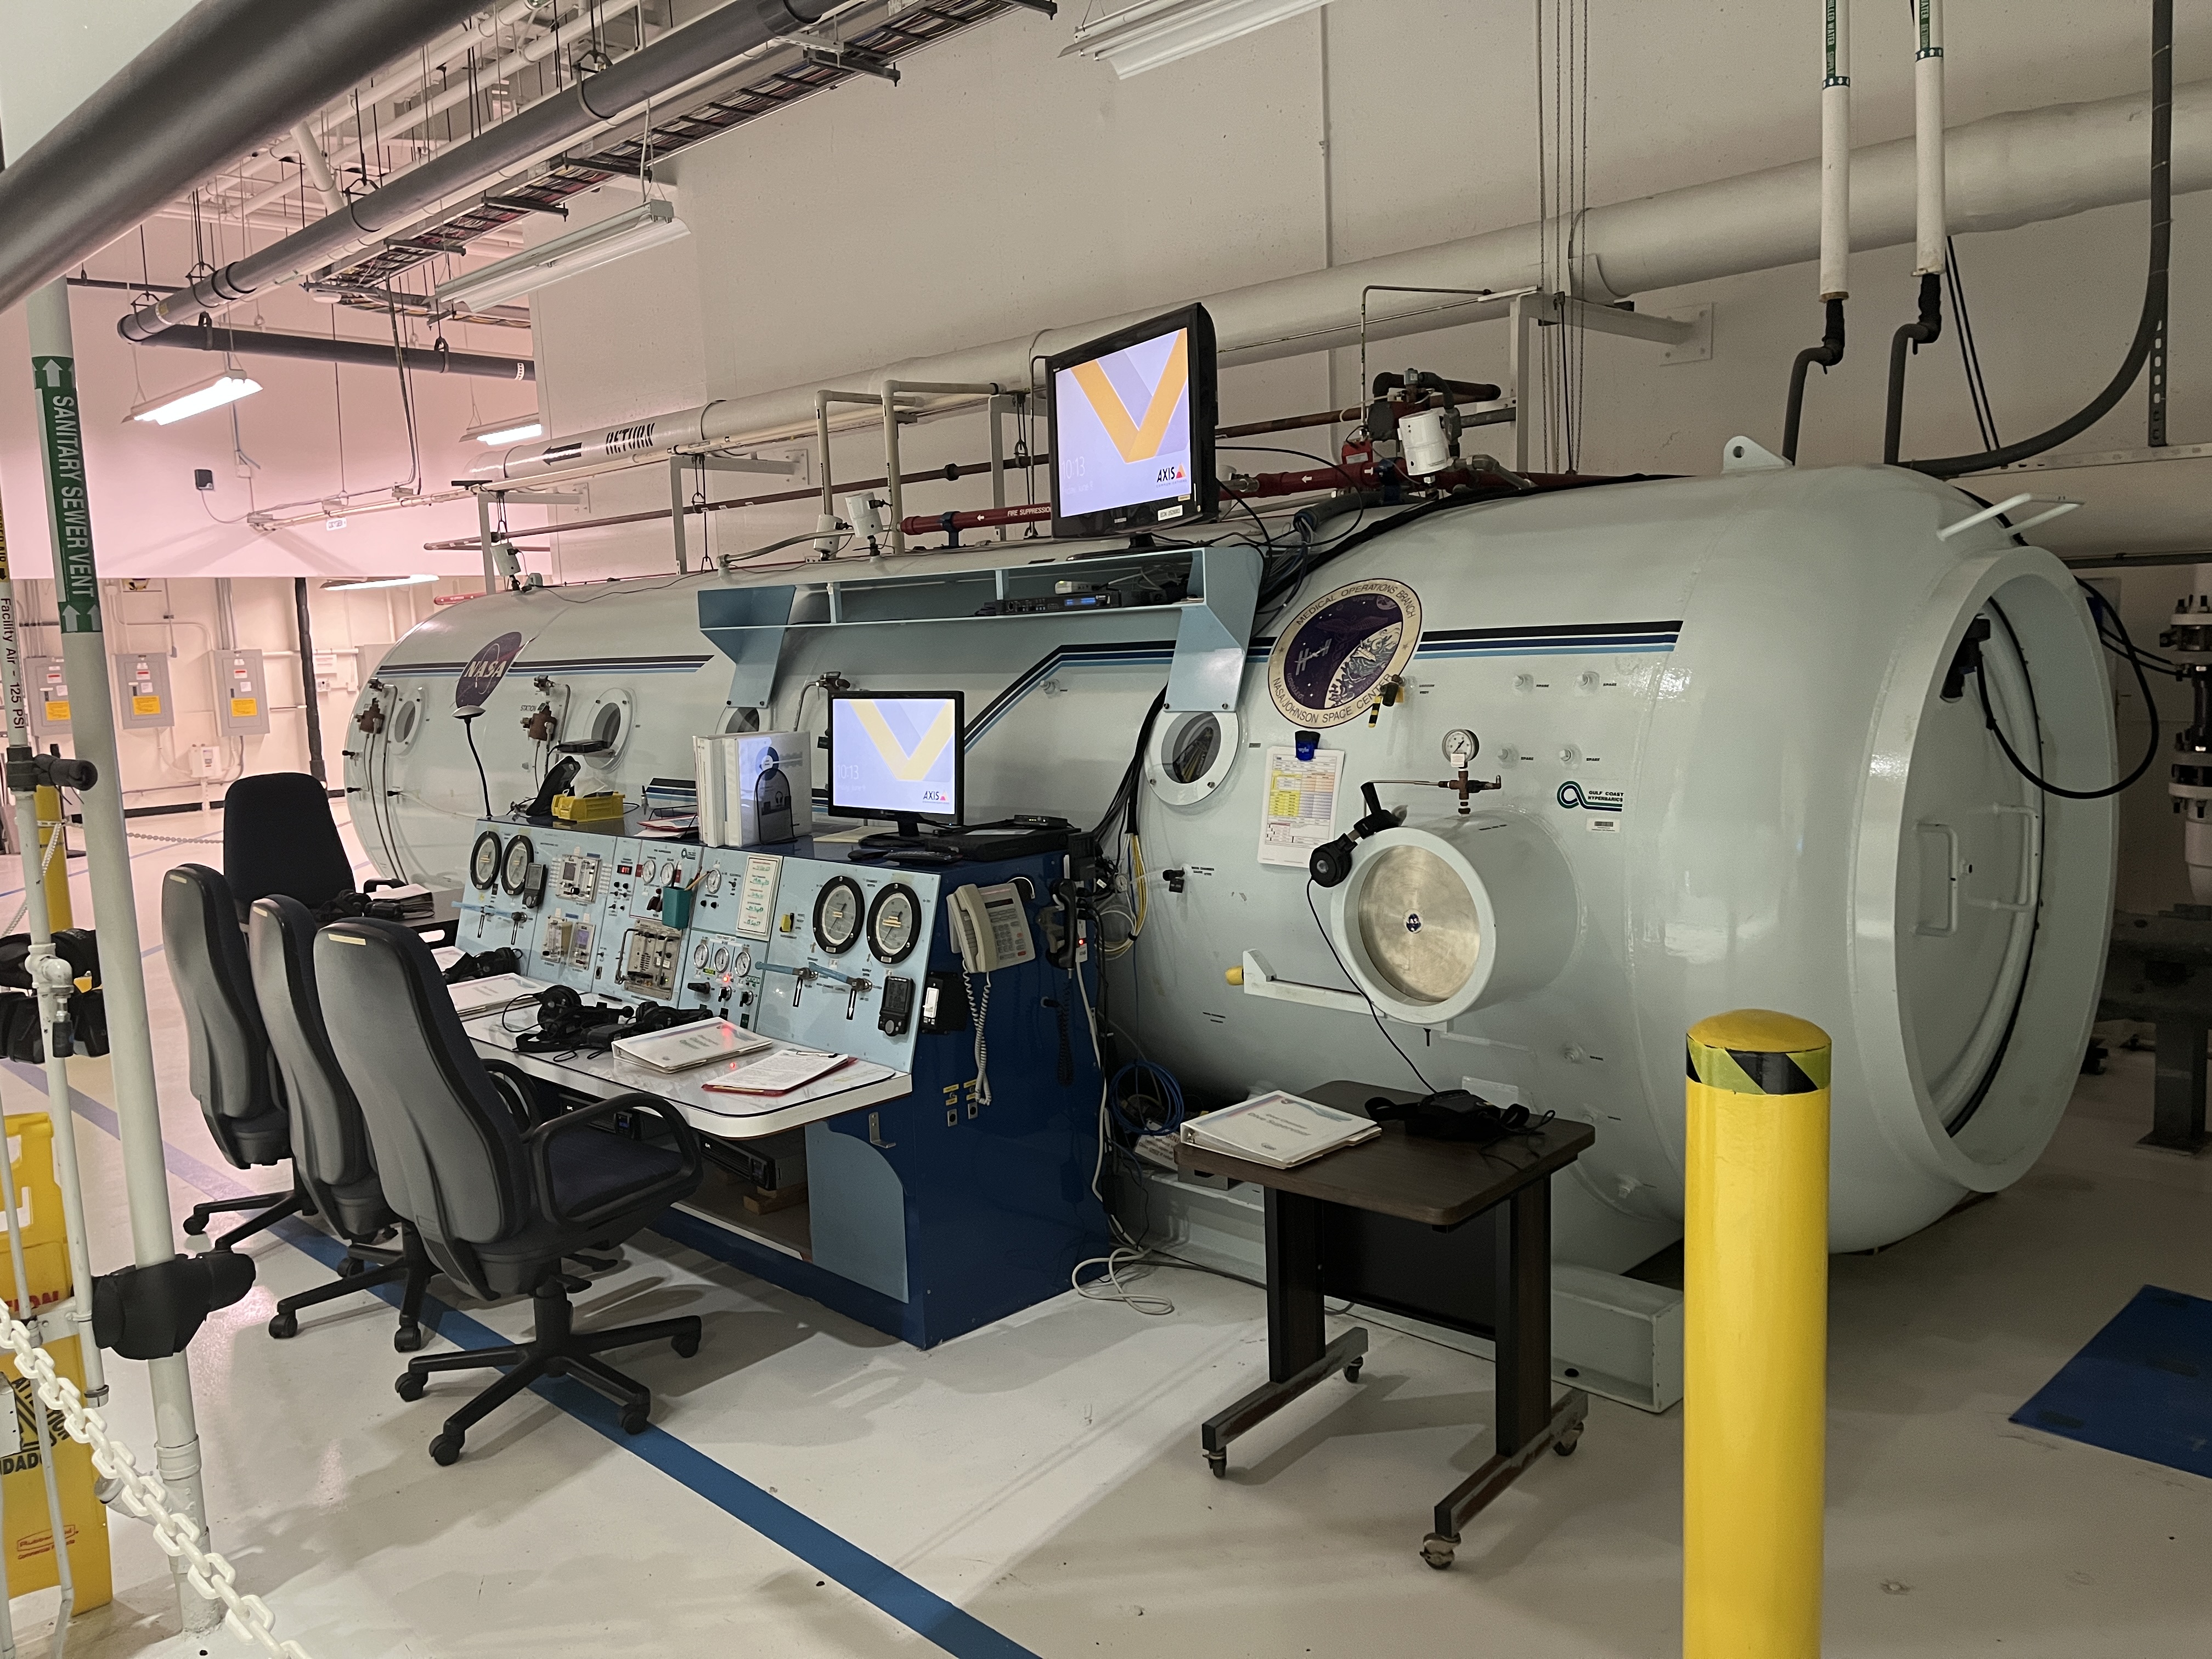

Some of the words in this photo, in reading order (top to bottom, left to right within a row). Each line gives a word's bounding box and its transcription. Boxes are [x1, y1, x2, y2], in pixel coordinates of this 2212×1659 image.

[1826, 0, 1836, 21] HILLED
[1920, 0, 1929, 19] ATER
[1826, 22, 1836, 46] WATER
[1920, 24, 1930, 48] RETURN
[1826, 50, 1836, 75] SUPPLY
[53, 394, 82, 480] SANITARY
[606, 422, 655, 455] RETURN
[1061, 456, 1086, 480] 10:13
[1156, 466, 1176, 483] AXIS
[61, 486, 89, 550] SEWER
[1019, 506, 1051, 516] SUPPRESSIO
[69, 552, 95, 599] VENT
[1296, 596, 1337, 625] MEDICAL
[1341, 583, 1398, 597] OPERATIONS
[1396, 590, 1417, 619] BRANCH
[1, 598, 13, 642] Facility
[5, 647, 16, 664] Air
[464, 661, 507, 678] NASA
[10, 682, 22, 703] 125
[1273, 677, 1319, 724] NASA/JOHNSON
[1322, 707, 1353, 723] SPACE
[1356, 673, 1393, 709] CENTER
[13, 709, 25, 729] PSI
[837, 764, 860, 780] 10:13
[922, 791, 940, 800] AXIS
[0, 1452, 43, 1475] IDAD
